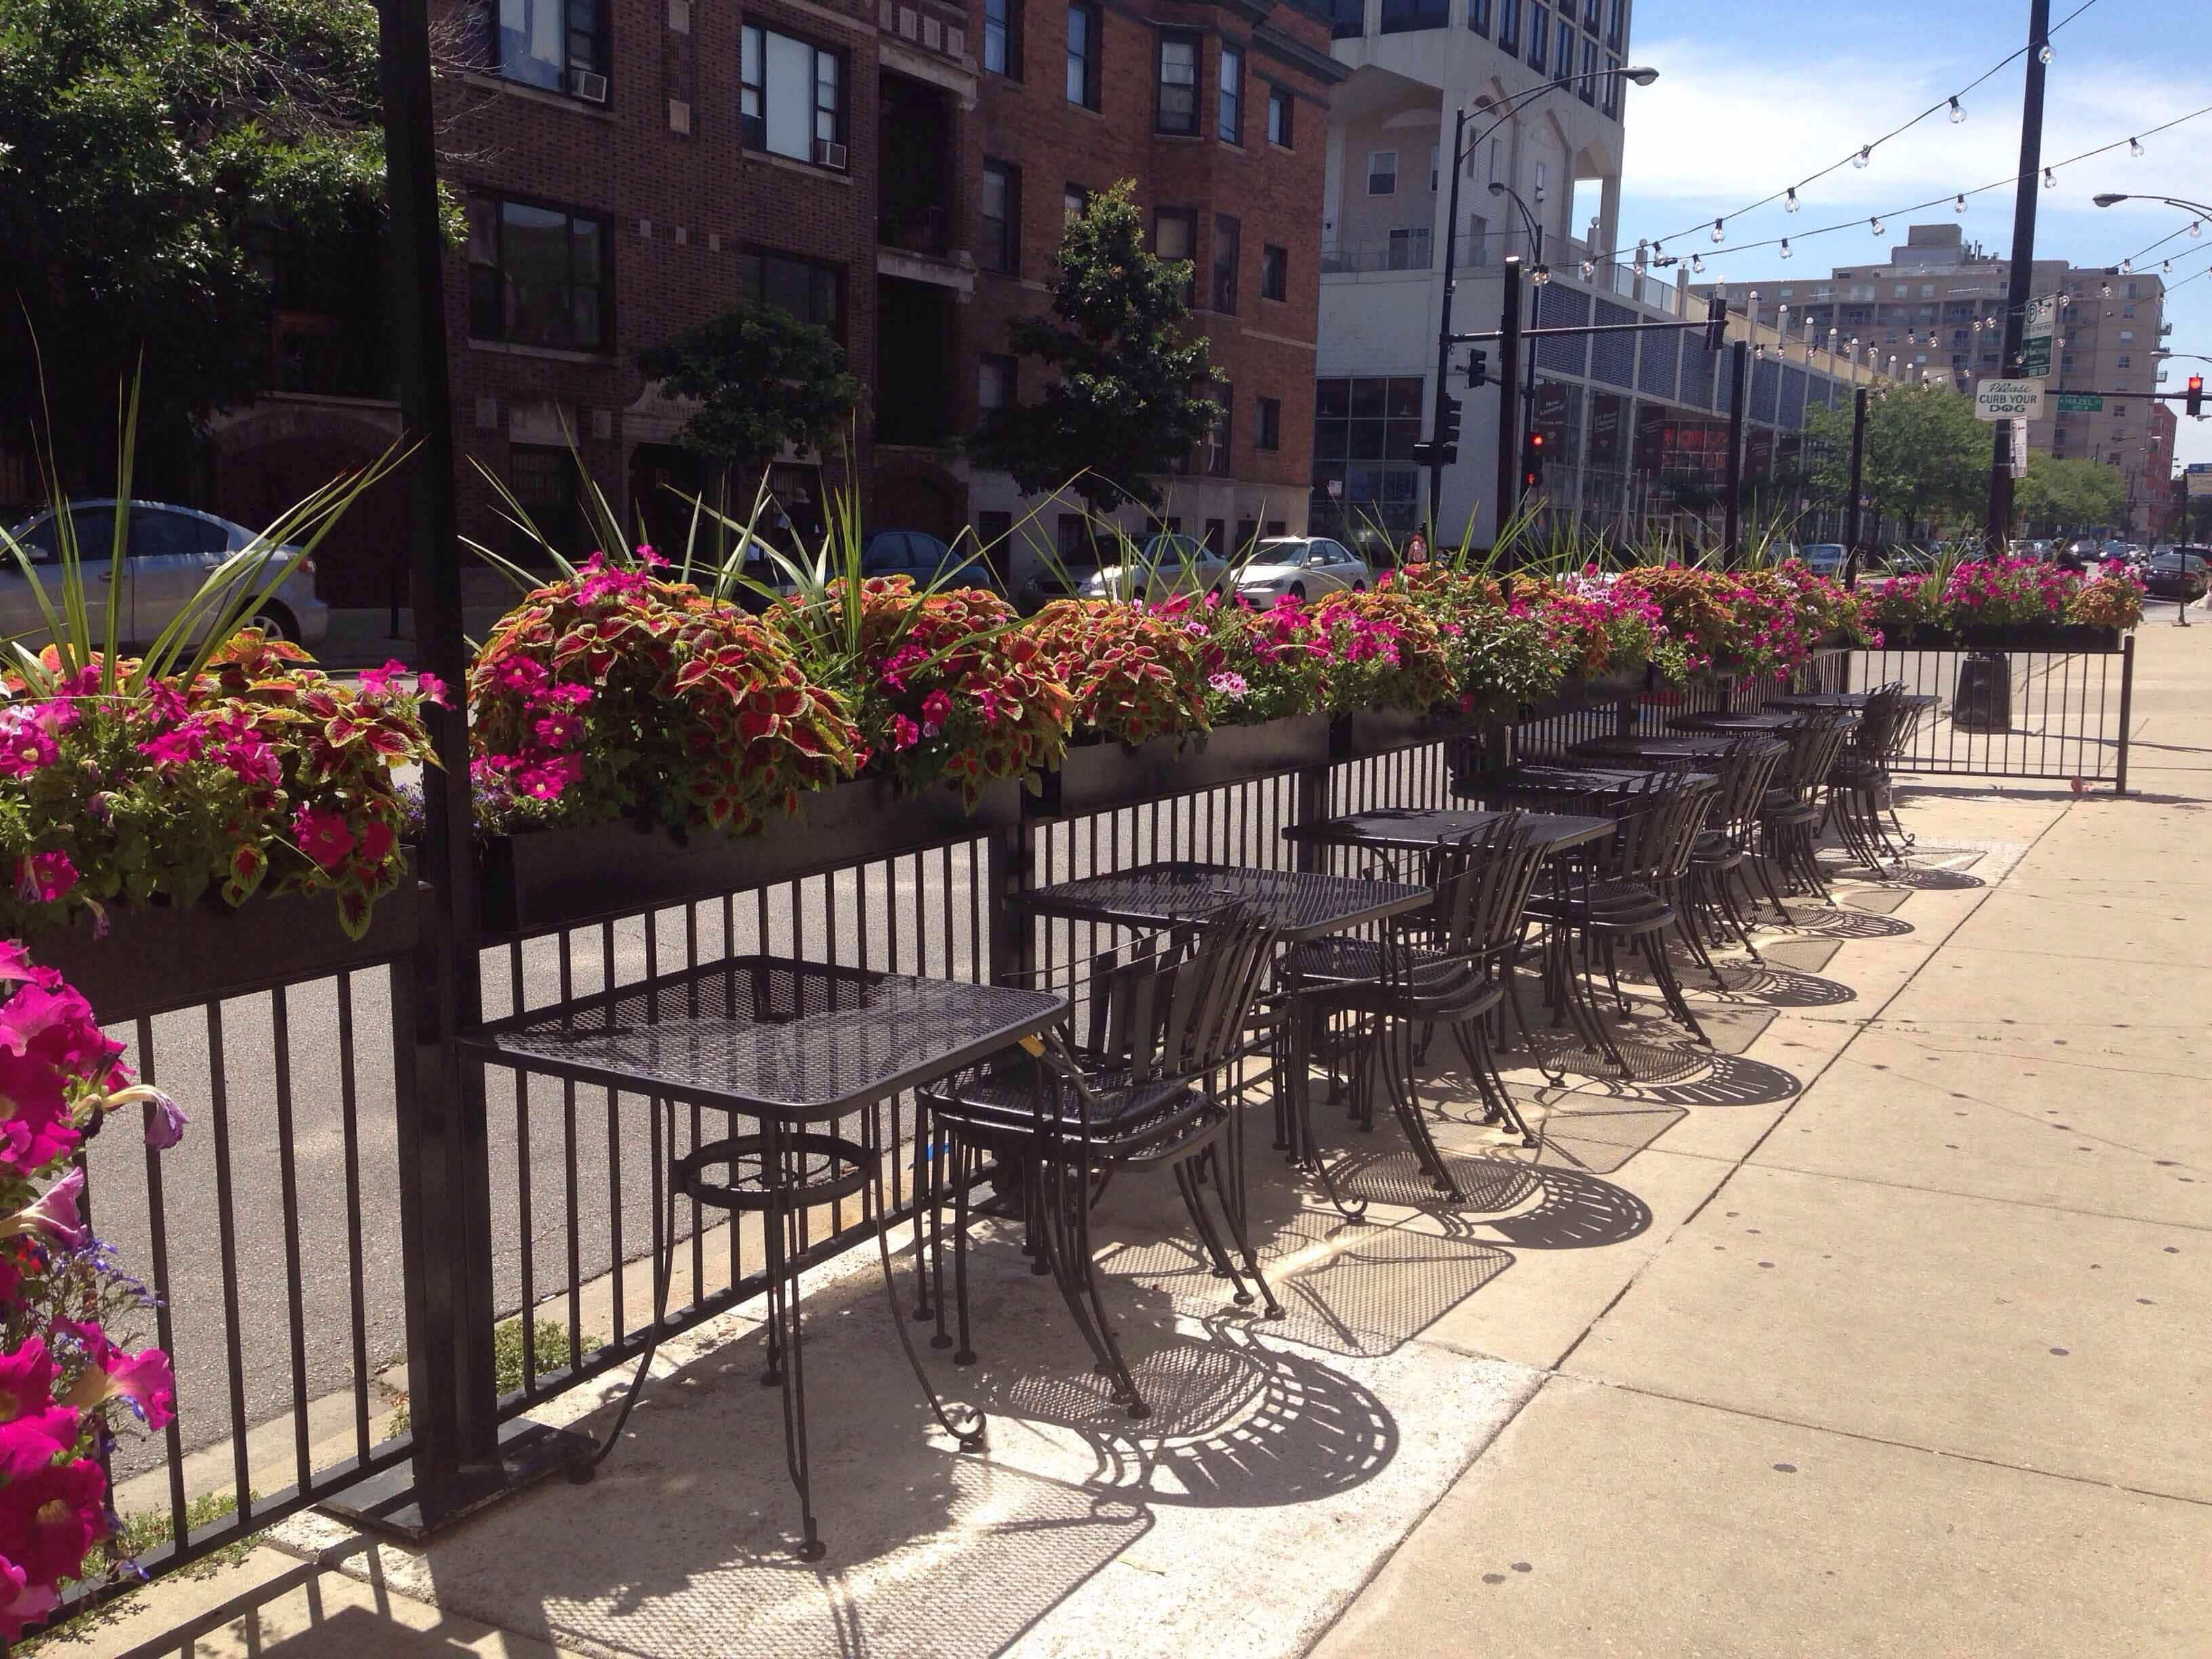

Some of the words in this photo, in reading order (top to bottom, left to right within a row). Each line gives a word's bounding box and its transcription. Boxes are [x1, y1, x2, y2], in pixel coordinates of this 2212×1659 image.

[1989, 383, 2032, 392] Please
[1980, 394, 2007, 404] CURB
[2010, 394, 2037, 404] YOUR
[1989, 404, 2026, 413] DOG
